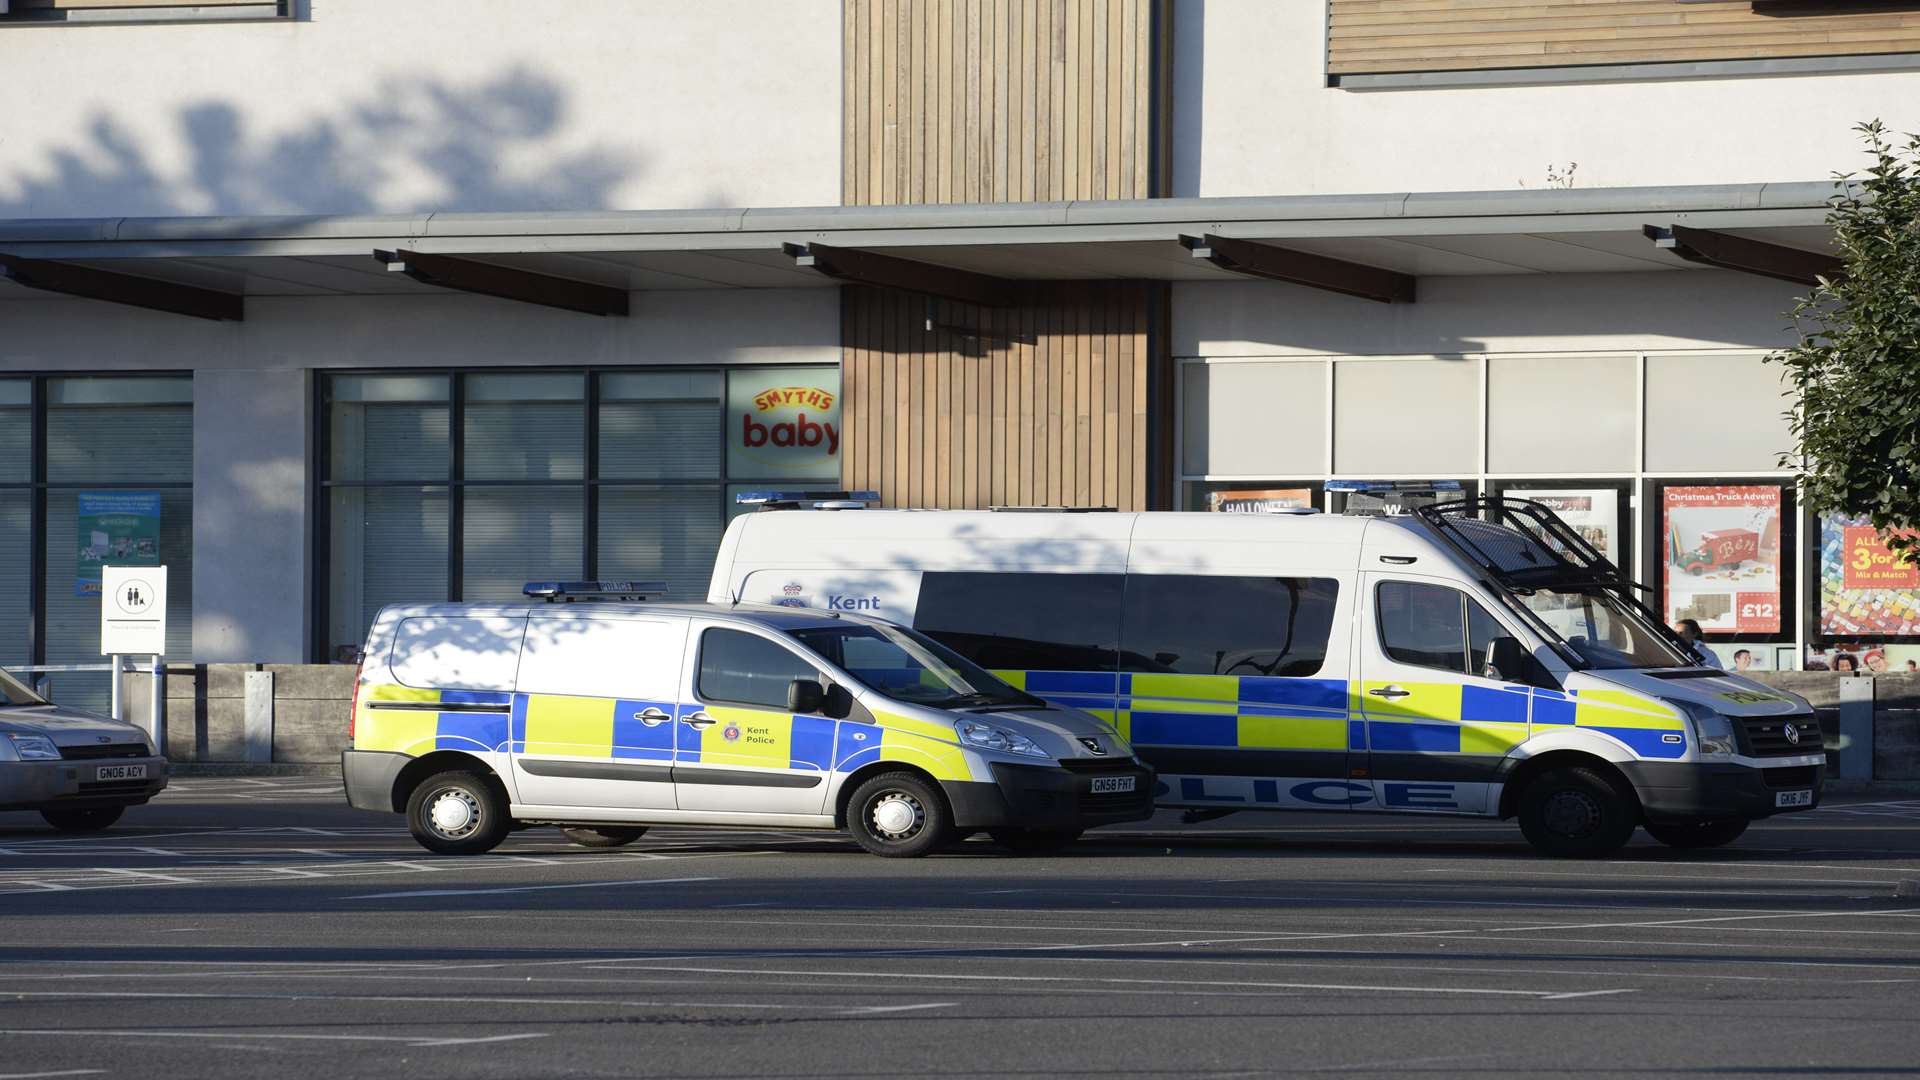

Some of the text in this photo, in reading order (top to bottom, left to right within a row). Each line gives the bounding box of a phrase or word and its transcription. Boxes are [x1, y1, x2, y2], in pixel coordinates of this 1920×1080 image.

[755, 390, 833, 411] SMYTHS
[744, 413, 839, 455] baby
[1668, 493, 1776, 501] Christmas Truck Advent
[1855, 537, 1878, 547] ALL
[1851, 548, 1871, 570] 3
[1871, 553, 1893, 565] for
[1855, 571, 1871, 579] Mix
[828, 595, 881, 610] Kent
[1742, 603, 1774, 618] £12
[747, 727, 769, 735] Kent
[746, 736, 775, 744] Police
[100, 766, 143, 779] GN06 ACY
[1094, 778, 1132, 791] GN58 FHT
[1152, 777, 1458, 809] LICE
